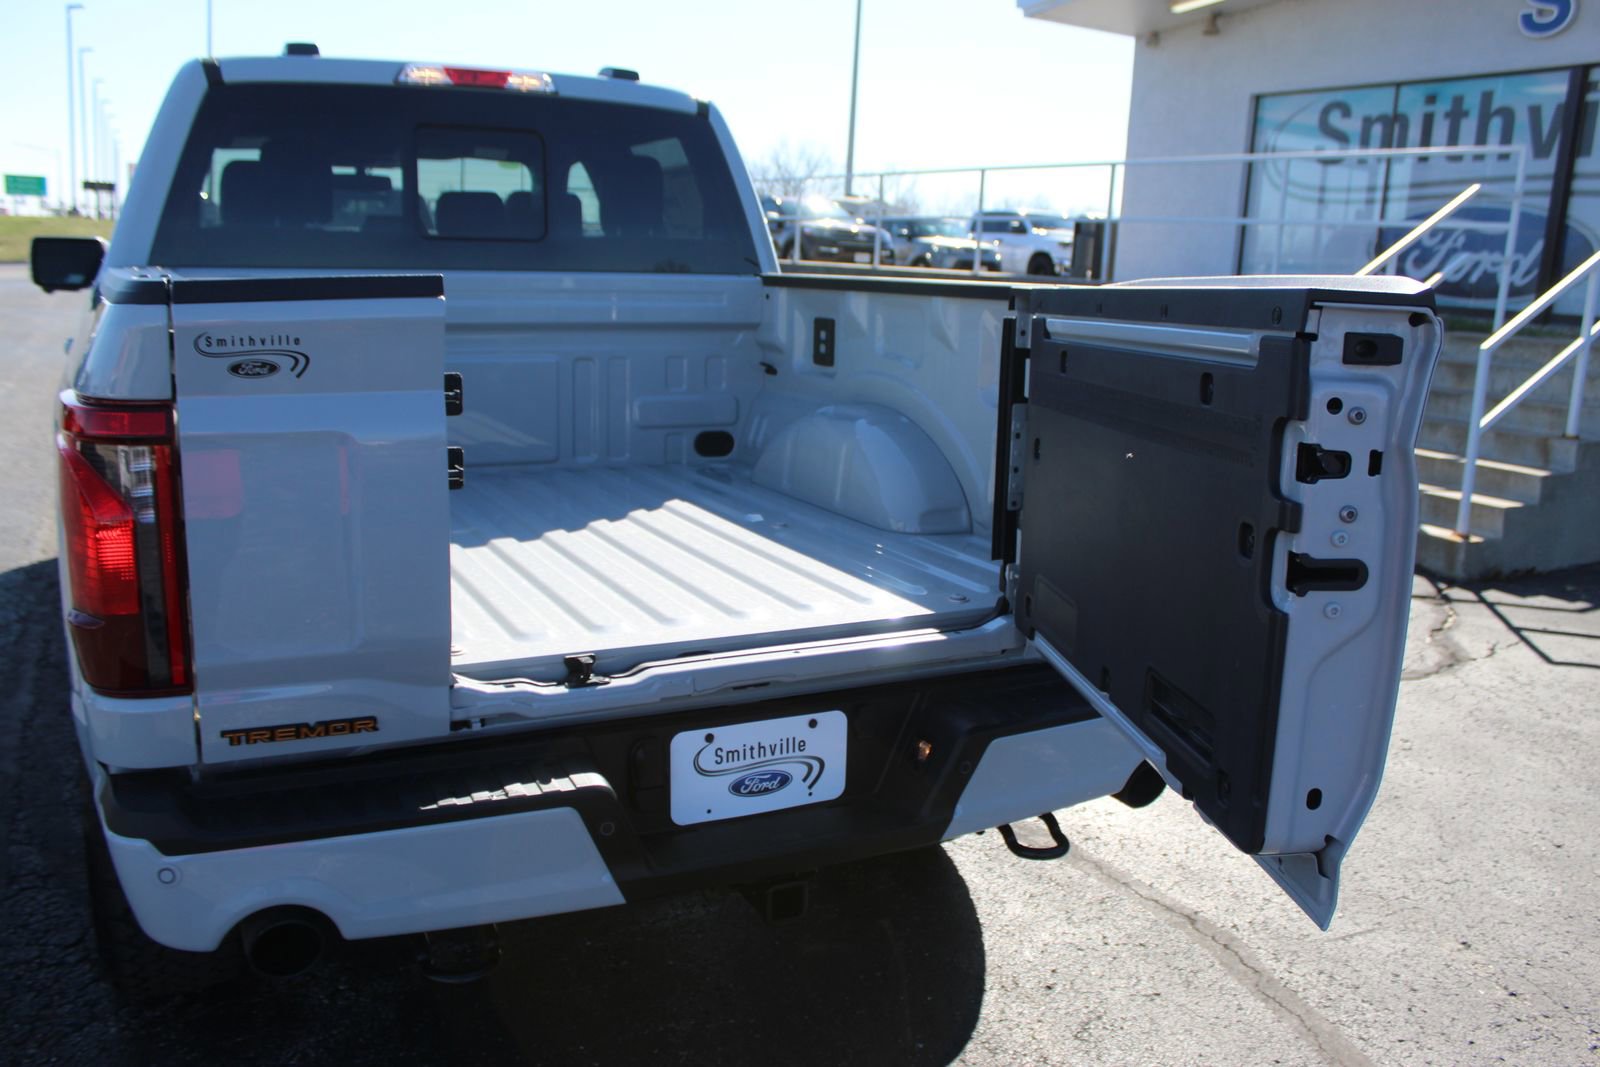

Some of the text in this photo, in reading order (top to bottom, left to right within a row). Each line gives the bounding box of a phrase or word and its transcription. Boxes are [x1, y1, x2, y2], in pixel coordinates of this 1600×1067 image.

[1404, 217, 1545, 288] Ford
[205, 335, 301, 348] Smithville
[238, 361, 270, 375] Ford
[221, 715, 379, 746] TREMOR
[714, 736, 807, 765] Smithville
[740, 774, 781, 794] Ford
